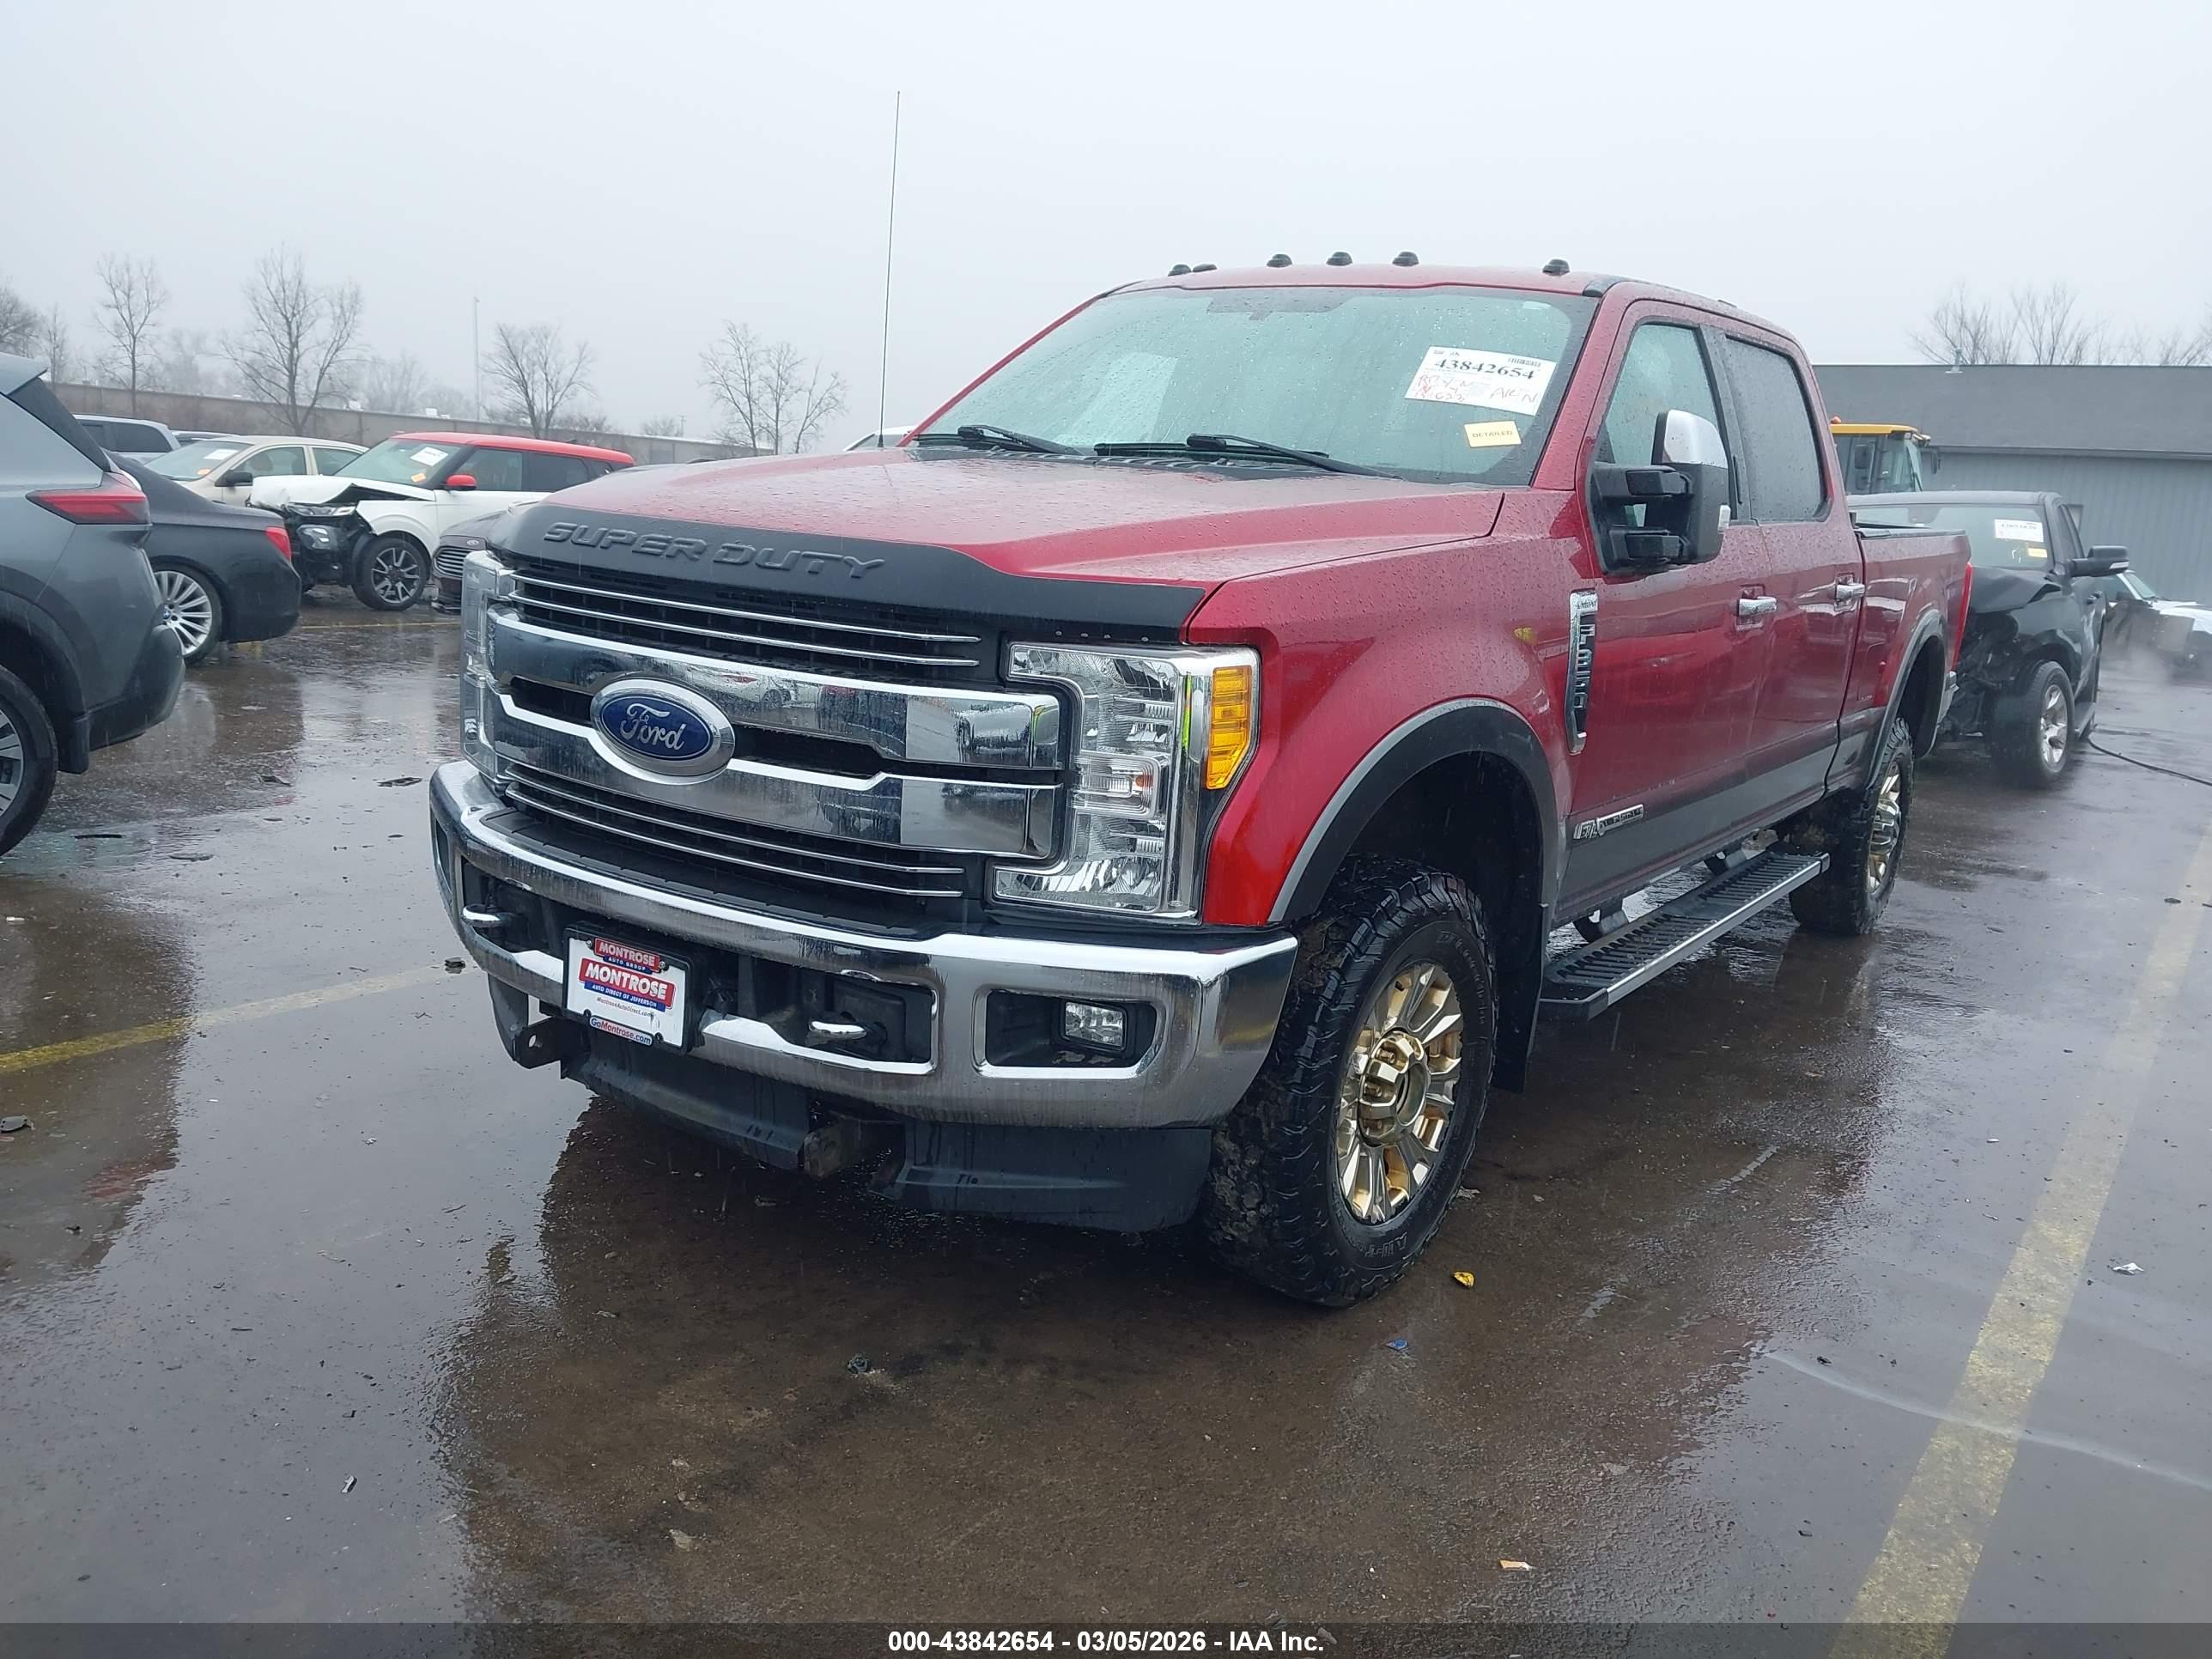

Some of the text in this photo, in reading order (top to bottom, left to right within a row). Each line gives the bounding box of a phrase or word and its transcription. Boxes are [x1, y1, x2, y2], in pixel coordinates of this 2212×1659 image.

[1435, 359, 1535, 380] 43842654
[1472, 429, 1513, 439] DETAILED
[543, 520, 885, 579] SUPER DUTY
[619, 702, 687, 750] Ford
[599, 941, 655, 967] MONTROSE
[608, 957, 646, 971] AUTO GROUP
[585, 963, 668, 1000] MONTROSE
[592, 983, 604, 992] AUTO
[605, 988, 622, 998] DIRECT
[630, 995, 657, 1008] JEFFERSON
[591, 1018, 652, 1045] GoMontrose.com
